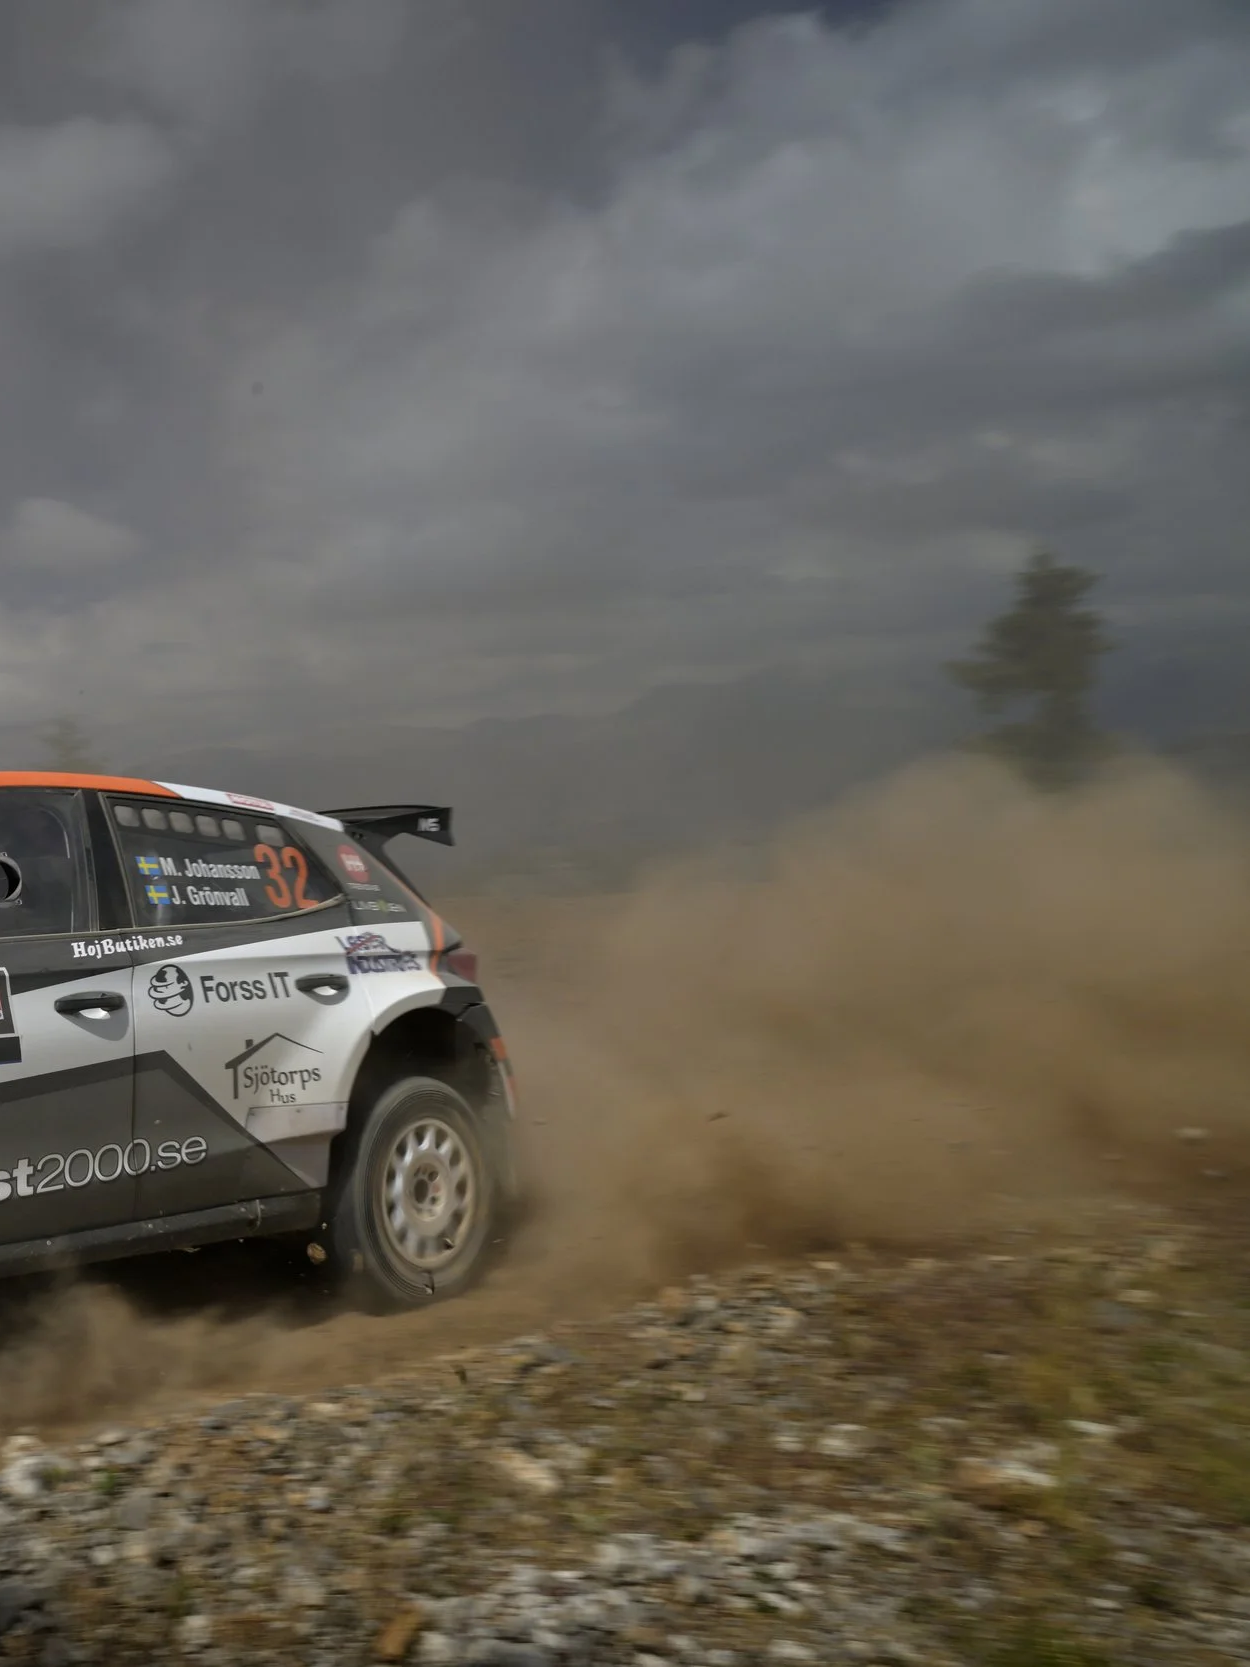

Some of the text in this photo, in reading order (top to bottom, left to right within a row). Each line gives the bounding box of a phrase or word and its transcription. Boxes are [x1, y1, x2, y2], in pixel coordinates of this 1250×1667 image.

[159, 857, 261, 880] M. Johansson
[253, 843, 319, 909] 32
[171, 885, 250, 907] J. Grönvall
[71, 934, 183, 959] HojButiken.se
[200, 971, 291, 1003] Forss IT
[243, 1065, 322, 1094] Sjötorps
[269, 1089, 296, 1104] Hus
